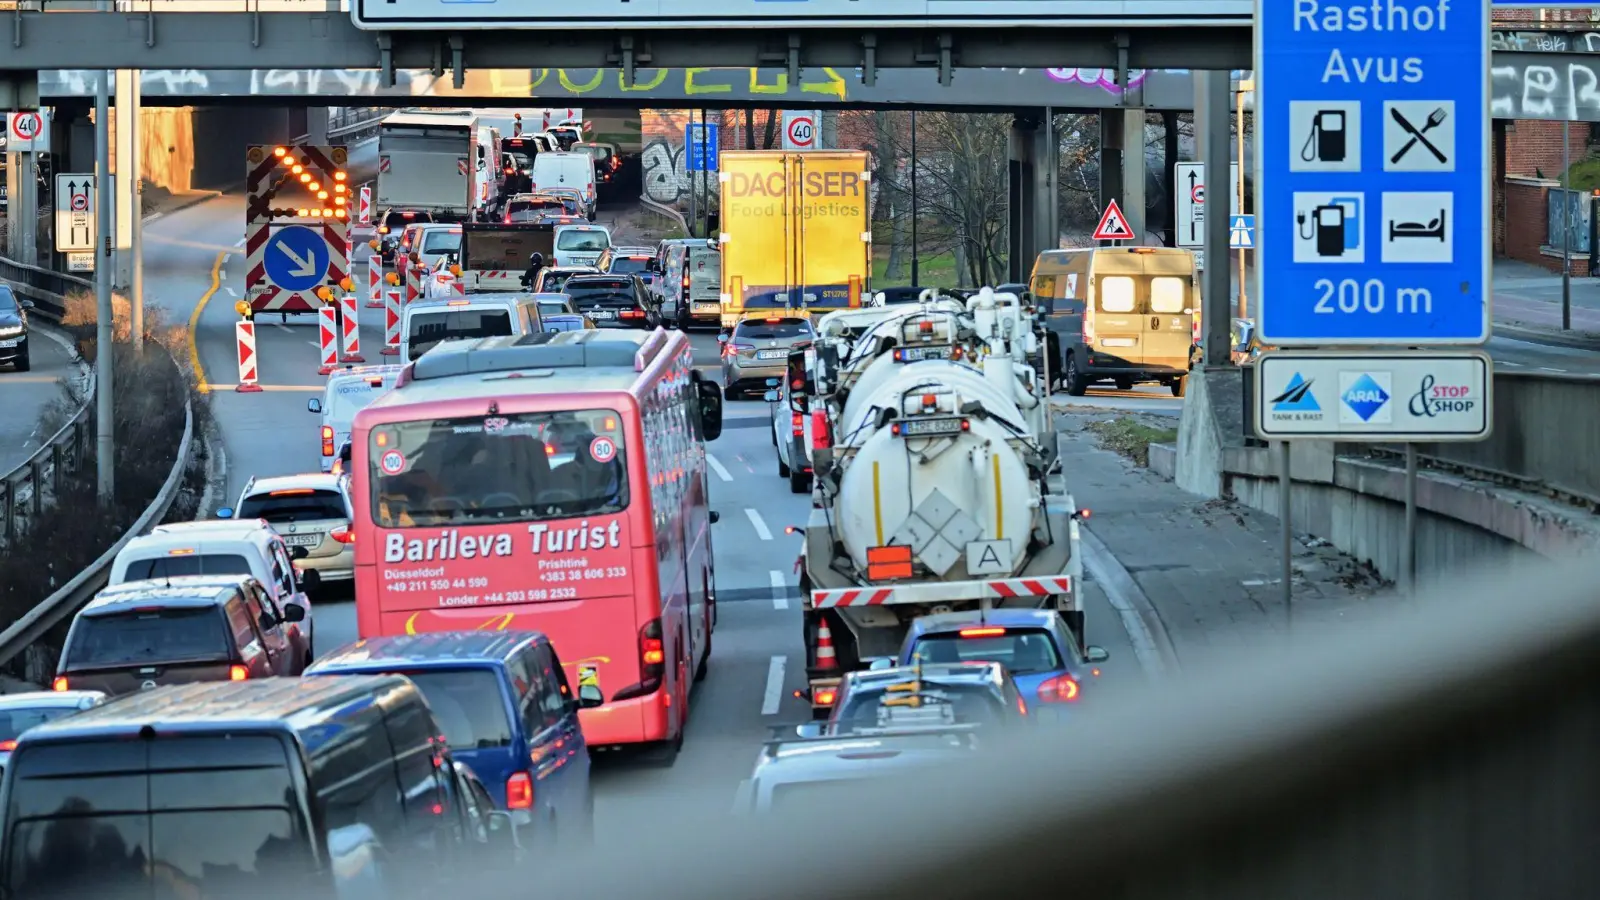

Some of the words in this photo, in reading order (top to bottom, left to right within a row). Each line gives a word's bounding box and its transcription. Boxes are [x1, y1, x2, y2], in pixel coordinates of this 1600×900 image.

[1293, 0, 1450, 31] Rasthof
[1321, 48, 1423, 83] Avus
[19, 118, 36, 132] 40
[794, 125, 811, 139] 40
[730, 171, 859, 198] DACHSER
[731, 203, 774, 217] Food
[781, 202, 859, 219] Logistics
[1313, 278, 1385, 314] 200
[1396, 286, 1432, 314] m
[1347, 390, 1385, 403] ARAL
[1408, 374, 1437, 418] &
[1434, 400, 1474, 412] SHOP
[1433, 385, 1469, 398] STOP
[1272, 413, 1293, 421] TANK
[1295, 413, 1302, 421] &
[1303, 413, 1323, 421] RAST
[386, 456, 401, 469] 100
[385, 529, 513, 563] Barileva
[528, 519, 620, 554] Turist
[978, 544, 1002, 568] A
[384, 567, 444, 580] Düsseldorf
[540, 570, 566, 582] +383
[568, 570, 582, 581] 38
[606, 566, 627, 578] 333
[387, 582, 406, 592] +49
[409, 581, 427, 592] 211
[430, 579, 450, 590] 550
[452, 579, 466, 589] 44
[468, 577, 488, 588] 590
[483, 592, 503, 603] +44
[505, 590, 525, 602] 203
[550, 587, 576, 599] 2532
